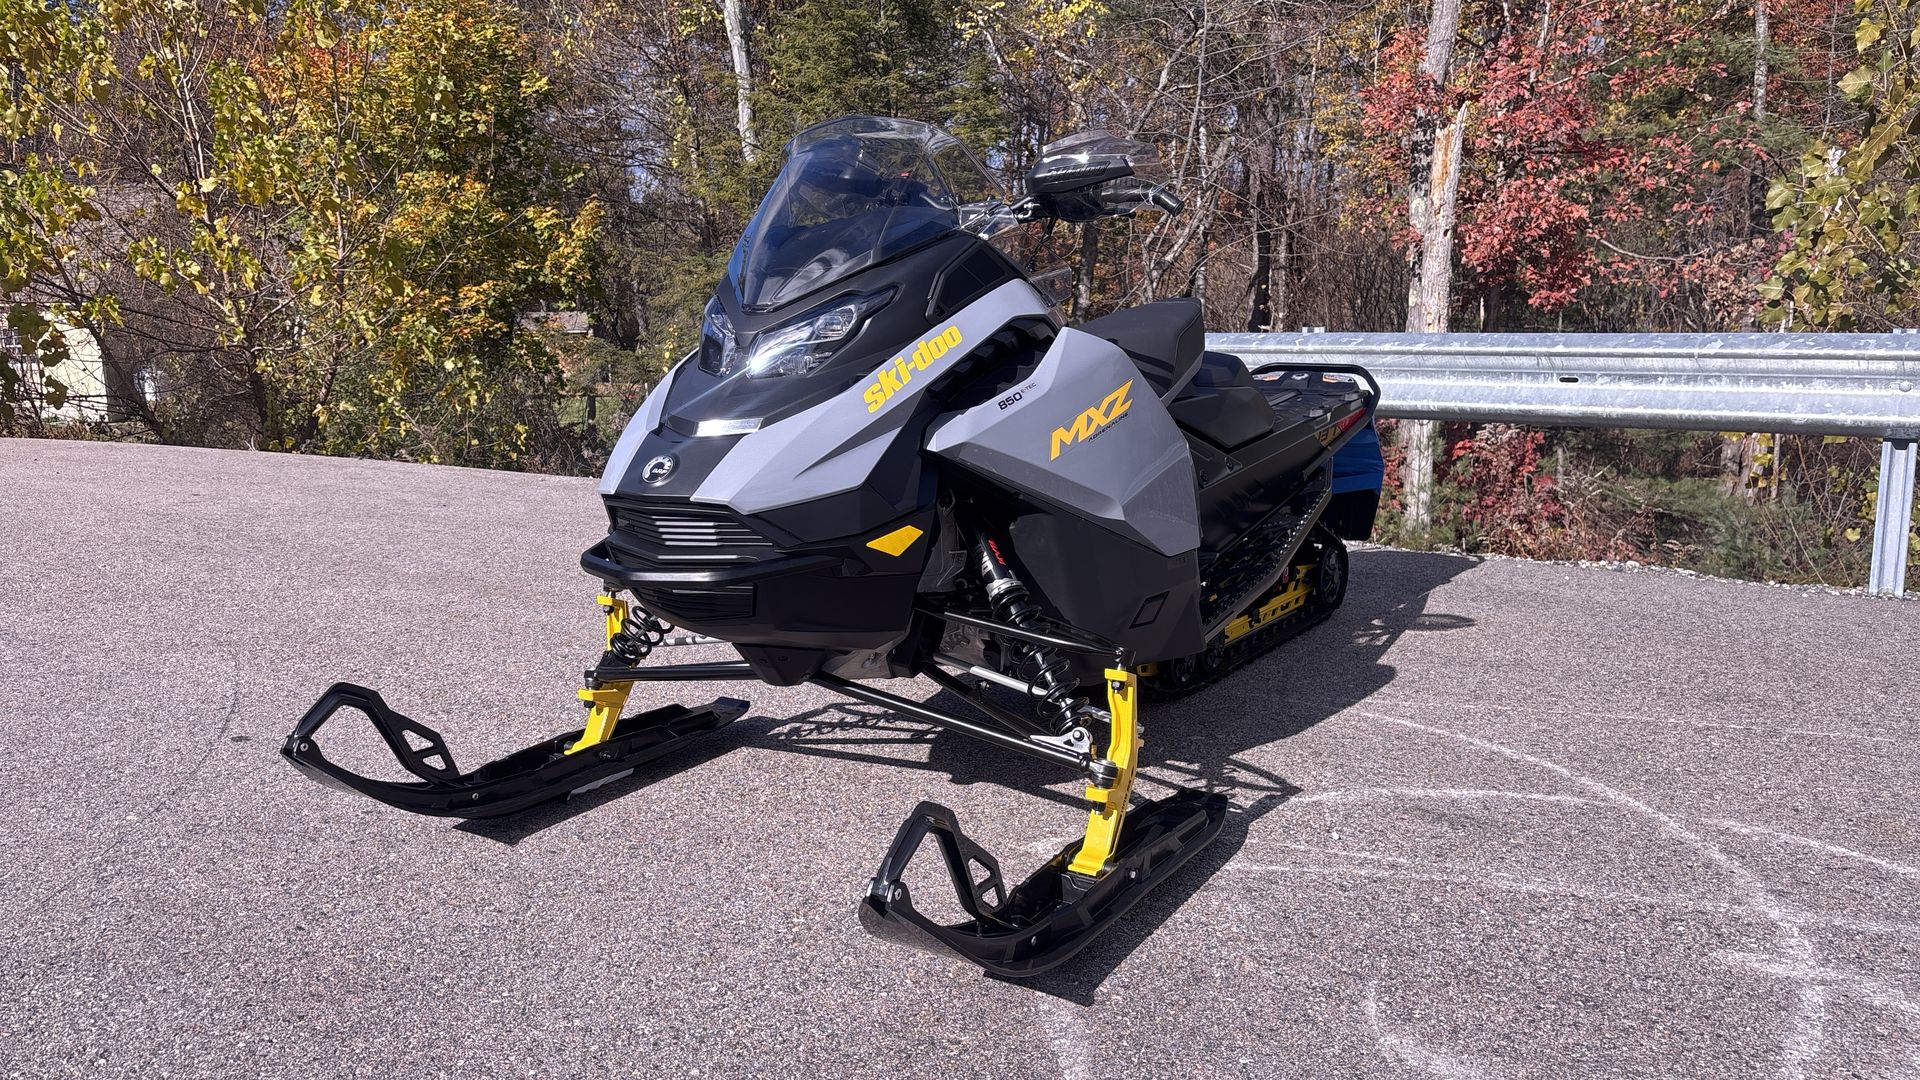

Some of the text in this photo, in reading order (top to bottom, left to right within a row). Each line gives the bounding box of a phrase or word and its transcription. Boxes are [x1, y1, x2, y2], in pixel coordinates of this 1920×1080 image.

[863, 325, 963, 413] ski-doo
[998, 392, 1023, 410] 850
[1049, 378, 1134, 461] MXZ
[1088, 411, 1129, 443] ADRENALINE
